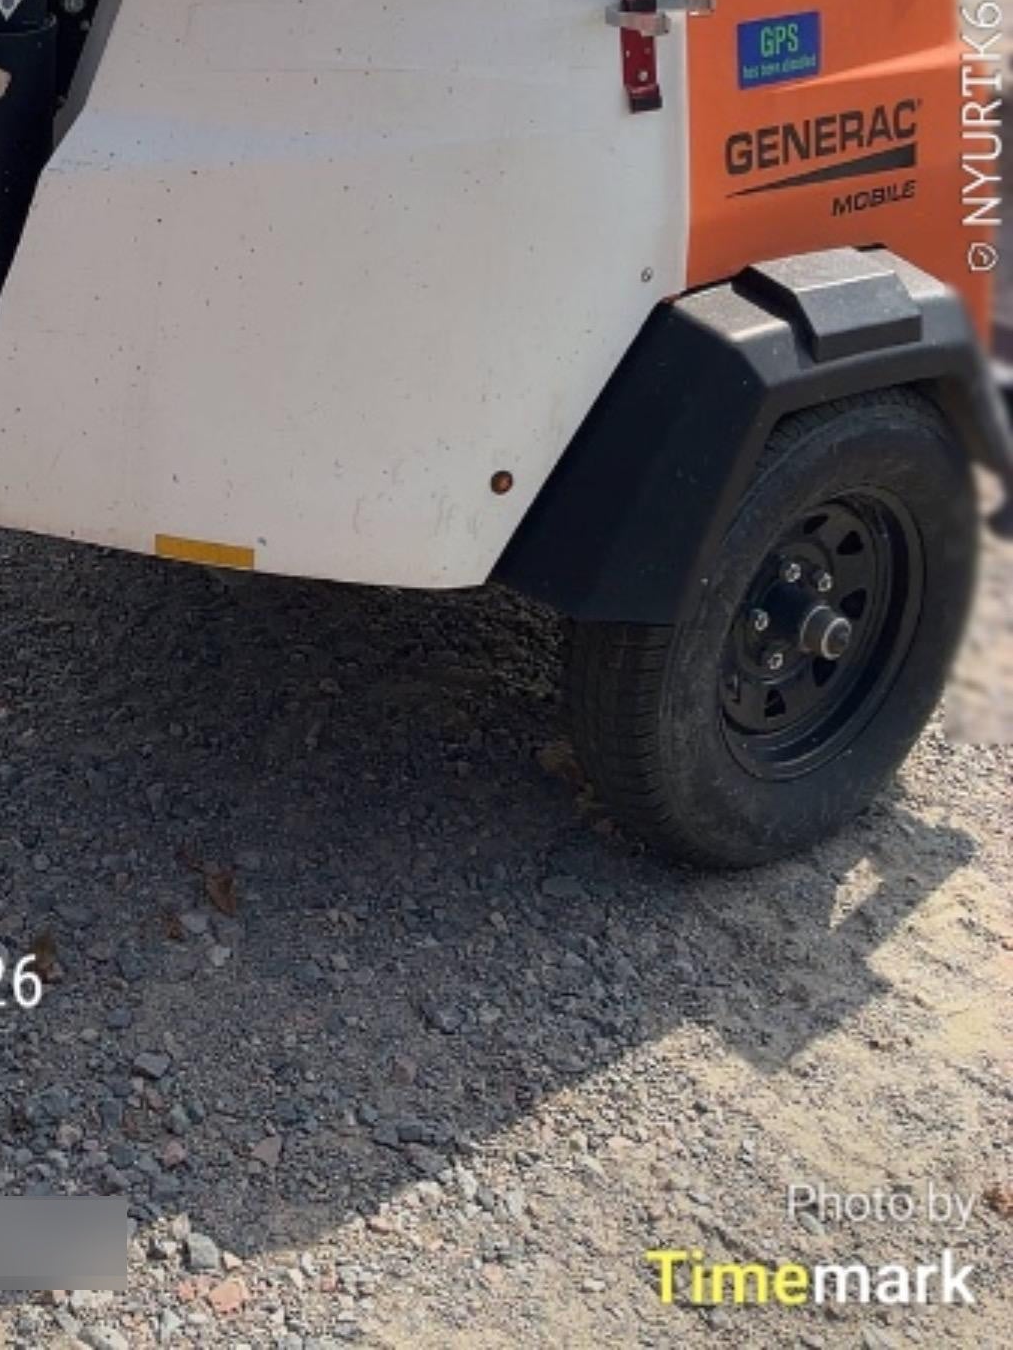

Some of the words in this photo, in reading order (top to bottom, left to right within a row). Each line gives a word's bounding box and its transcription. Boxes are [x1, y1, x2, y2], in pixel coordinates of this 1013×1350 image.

[760, 23, 799, 57] GPS
[725, 99, 916, 175] GENERAC
[832, 180, 916, 216] MOBILE
